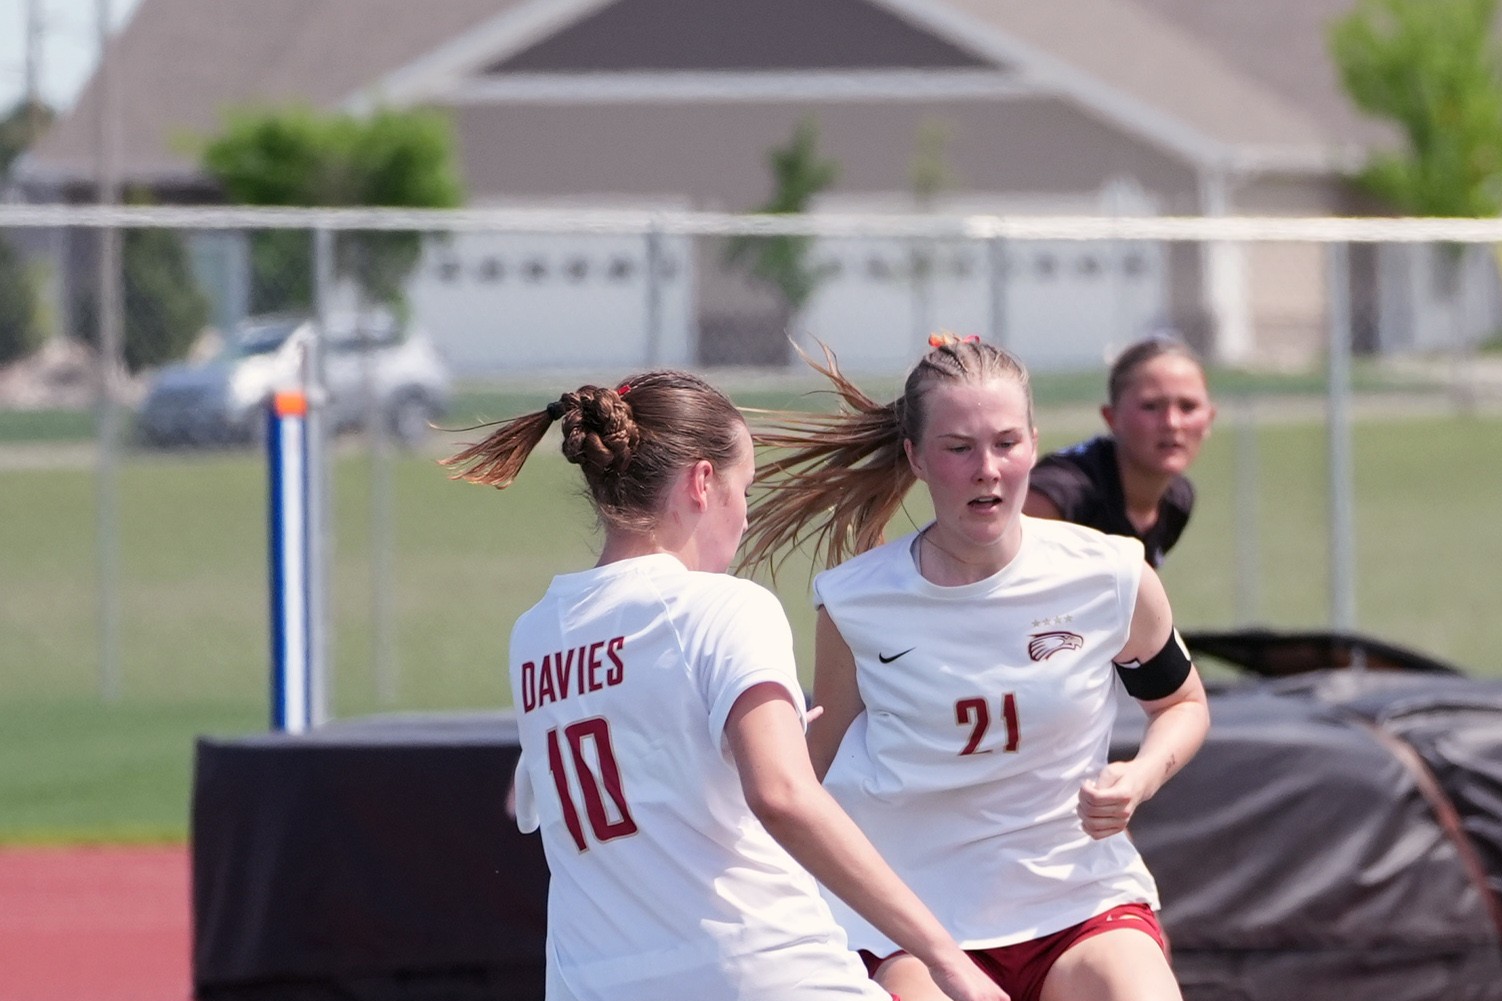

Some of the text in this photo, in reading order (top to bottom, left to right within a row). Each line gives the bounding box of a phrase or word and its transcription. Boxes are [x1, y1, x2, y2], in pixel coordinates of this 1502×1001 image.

[521, 636, 625, 714] DAVIES
[954, 691, 1021, 757] 21
[546, 715, 639, 854] 10
